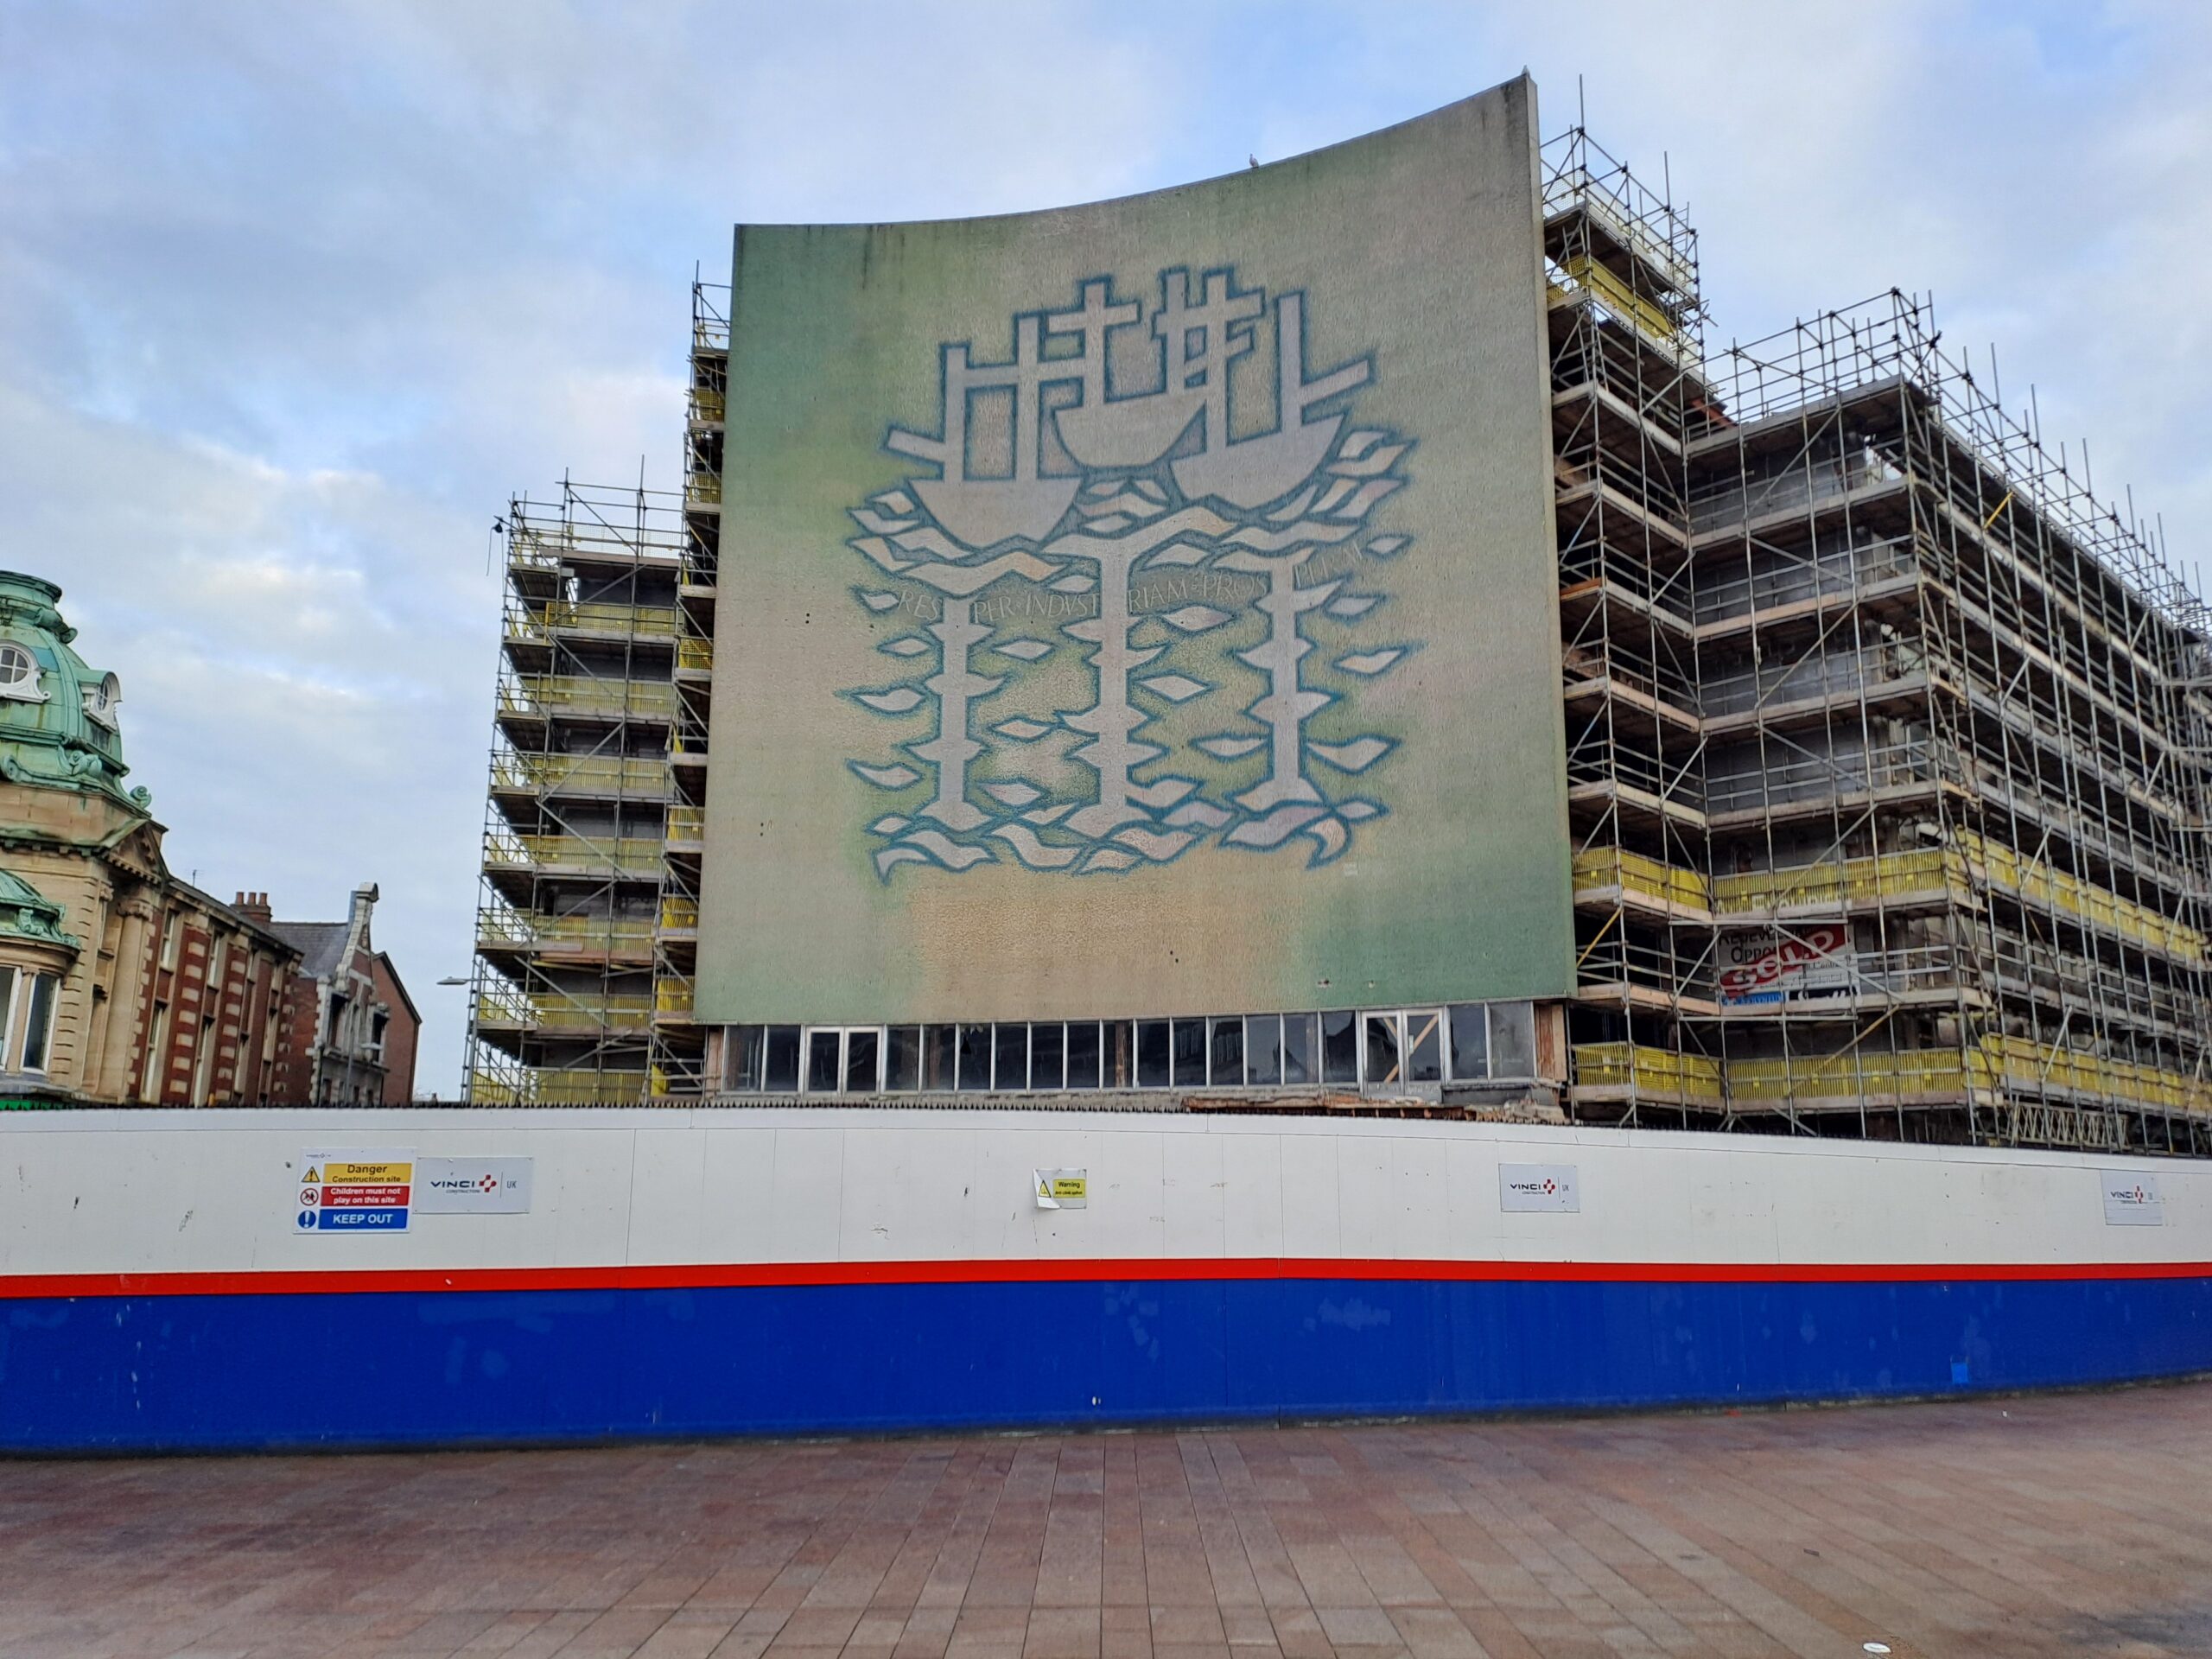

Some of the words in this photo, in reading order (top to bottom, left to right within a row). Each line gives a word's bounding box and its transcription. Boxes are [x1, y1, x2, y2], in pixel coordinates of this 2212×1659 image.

[347, 1164, 387, 1175] Danger
[506, 1180, 518, 1189] UK
[334, 1197, 351, 1205] play
[333, 1214, 365, 1224] KEEP
[367, 1214, 393, 1224] OUT
